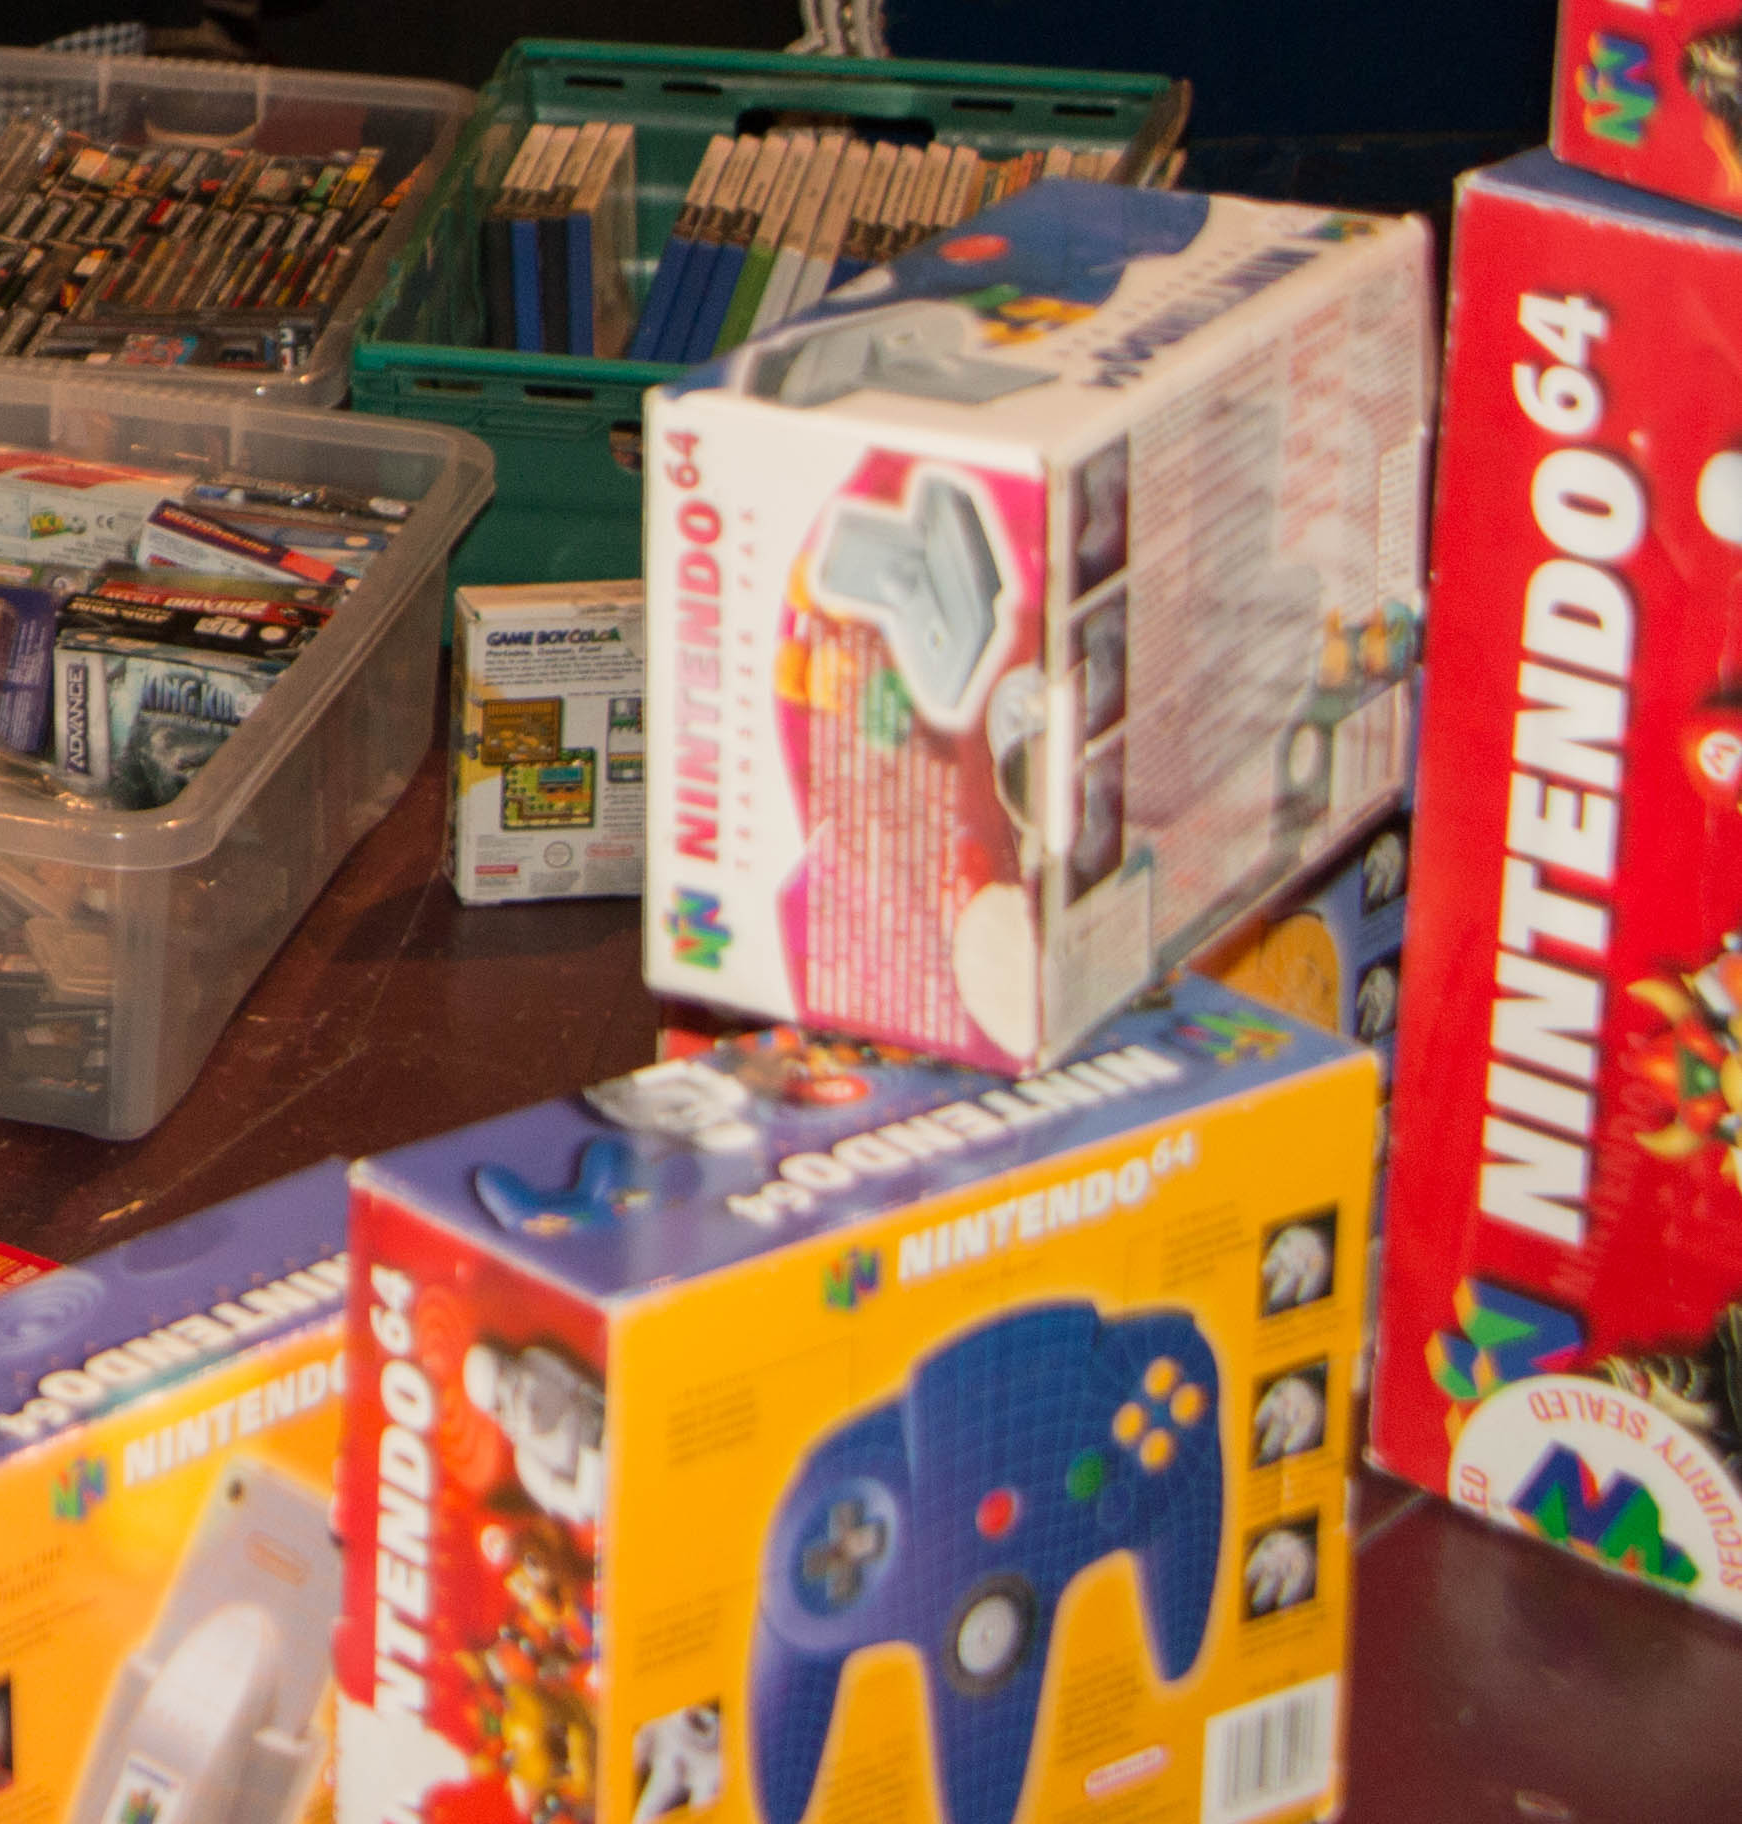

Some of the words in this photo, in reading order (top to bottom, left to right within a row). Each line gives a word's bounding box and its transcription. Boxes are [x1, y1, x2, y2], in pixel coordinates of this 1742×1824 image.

[486, 629, 533, 647] GAME
[536, 628, 569, 646] BOY
[674, 500, 723, 863] NINTENDO
[66, 663, 91, 776] ADVANCE
[1478, 448, 1650, 1249] NINTENDO
[777, 1044, 1185, 1201] NINTENDO
[897, 1161, 1150, 1282] NINTENDO
[1525, 1388, 1651, 1443] SEALED
[373, 1362, 437, 1722] NTENDO
